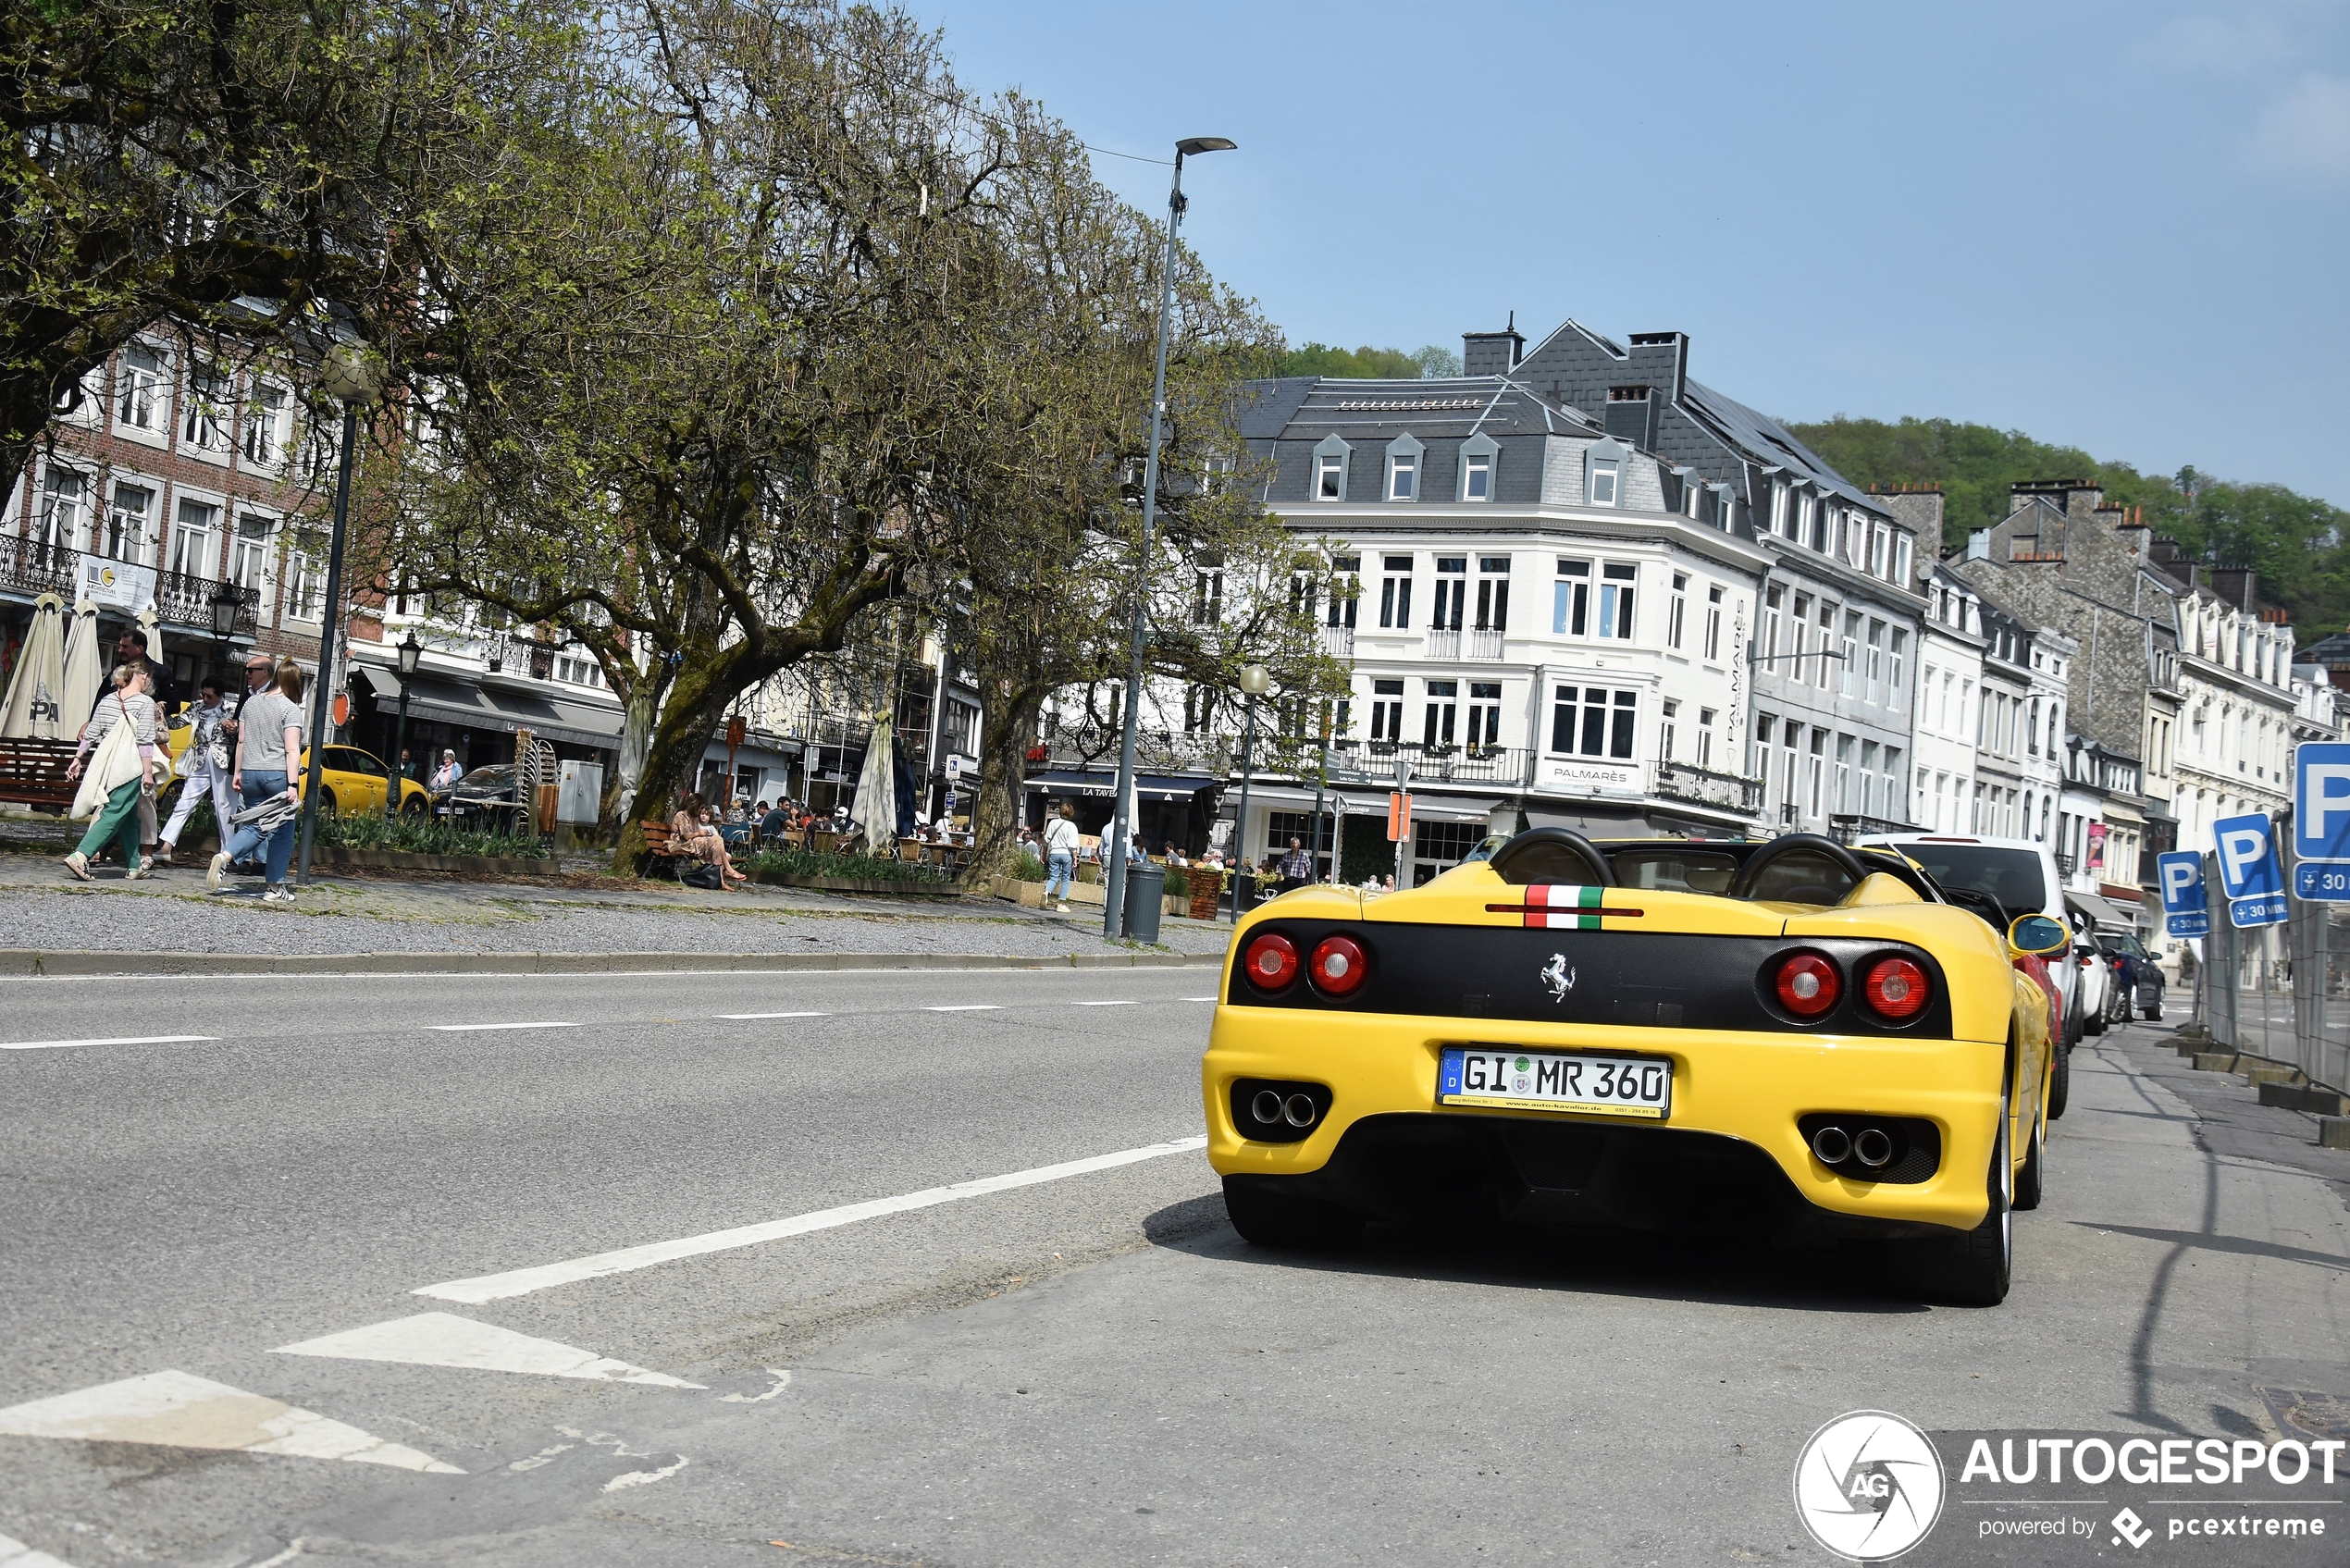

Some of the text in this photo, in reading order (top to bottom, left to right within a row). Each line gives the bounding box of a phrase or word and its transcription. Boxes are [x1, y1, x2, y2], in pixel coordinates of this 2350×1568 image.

[1727, 599, 1744, 742] PALMARÈS
[1553, 768, 1627, 783] PALMARÈS
[1095, 789, 1118, 797] TAVE
[2220, 829, 2267, 885] P
[2163, 862, 2198, 904] P
[2322, 874, 2345, 890] 30
[2249, 902, 2288, 918] 30 MIN.
[2180, 919, 2192, 929] 30
[1448, 1077, 1457, 1088] D
[1464, 1056, 1664, 1102] GI MR 360
[1505, 1101, 1602, 1112] www.auto-kavalier.de
